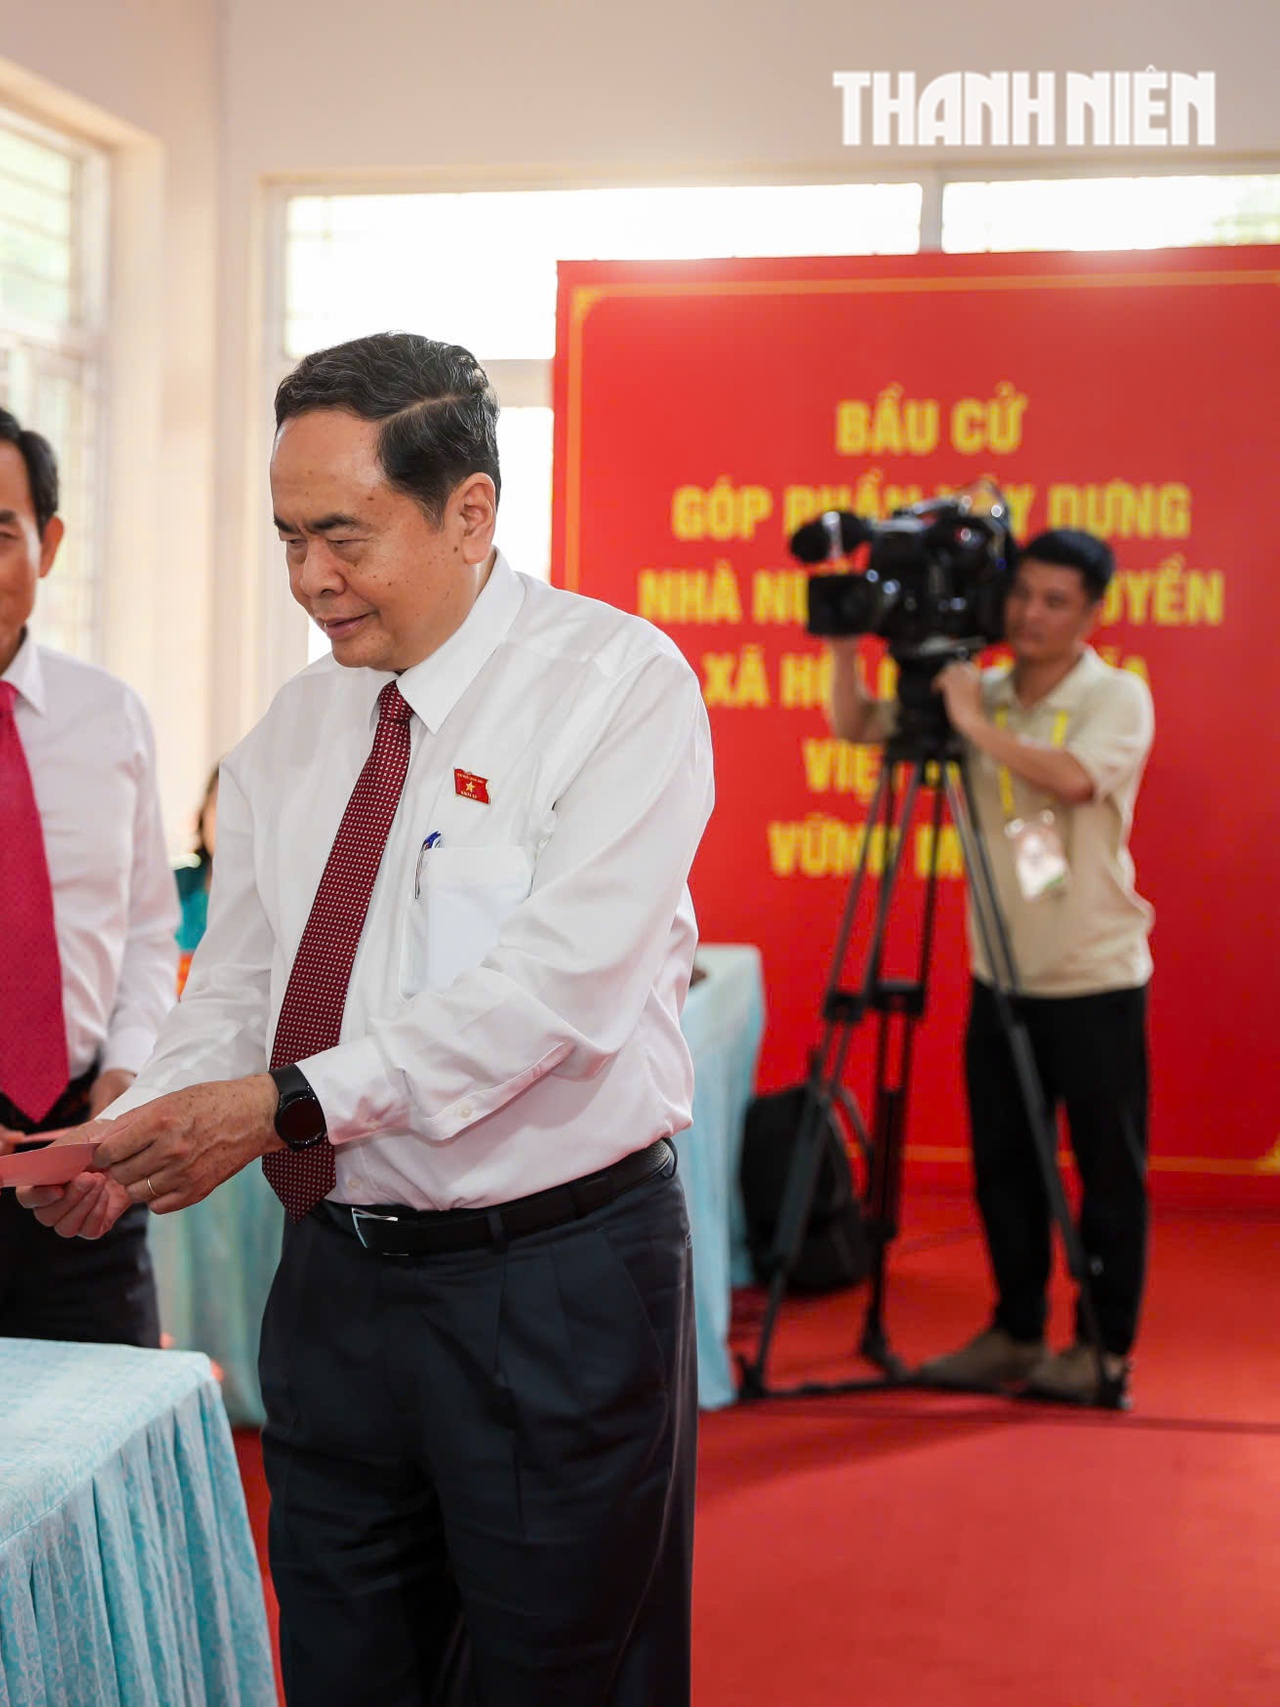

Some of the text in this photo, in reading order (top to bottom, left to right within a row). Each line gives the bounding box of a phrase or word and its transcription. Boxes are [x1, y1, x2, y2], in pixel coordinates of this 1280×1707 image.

[834, 380, 1028, 455] BẦU CỬ
[672, 474, 773, 541] GÓP
[638, 558, 743, 625] NHÀ
[1101, 552, 1225, 625] YỀN
[702, 643, 770, 708] XÃ
